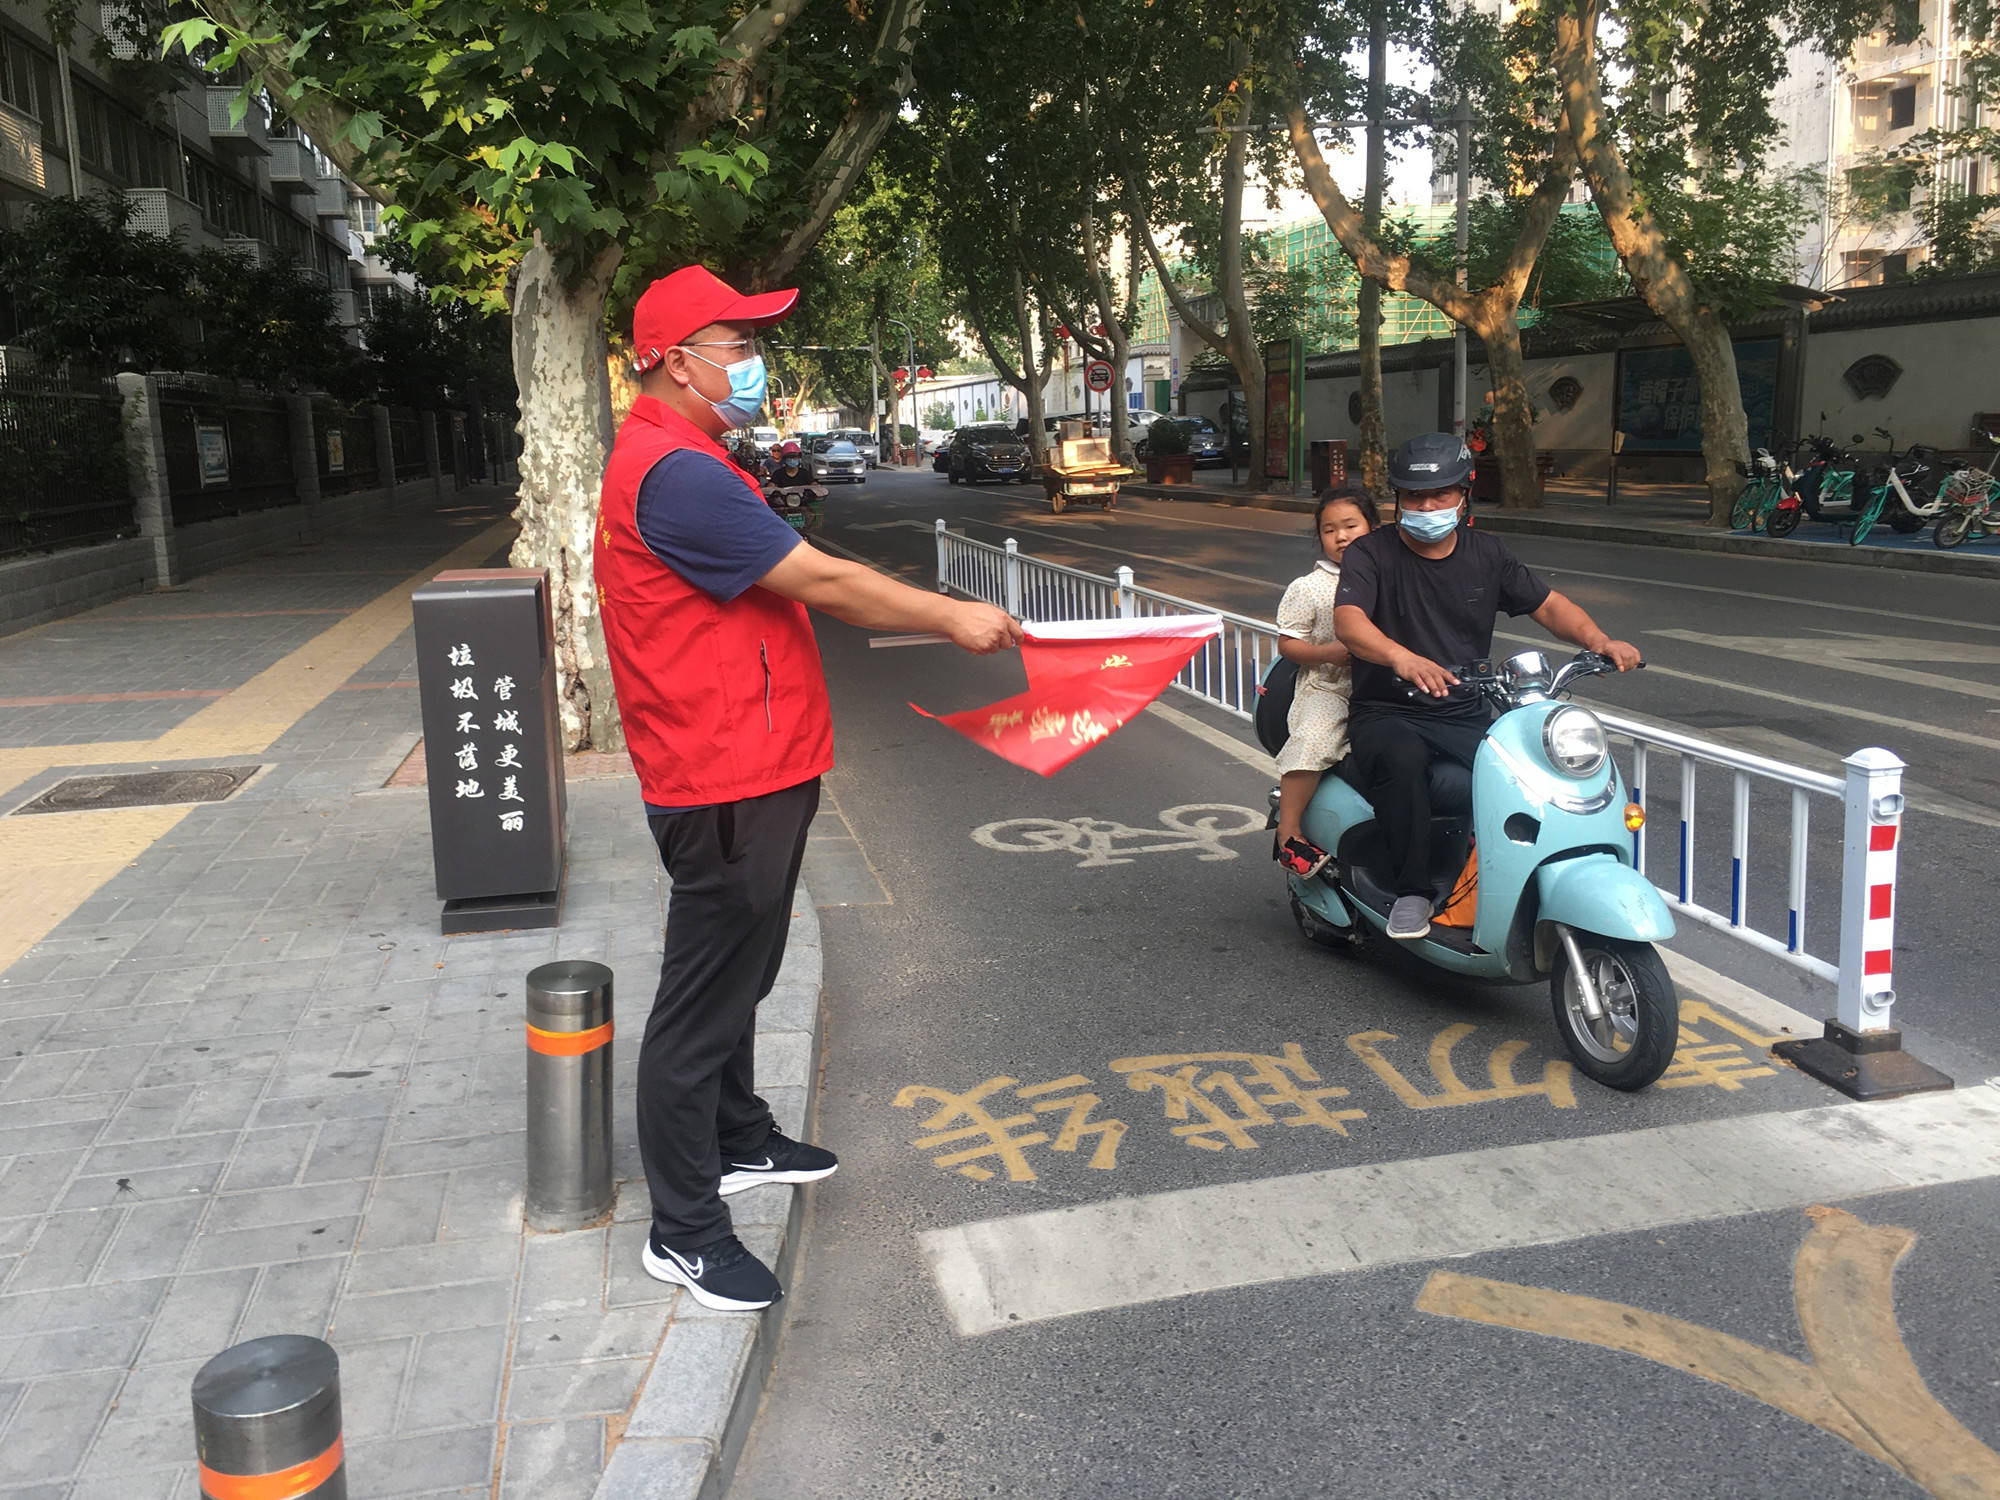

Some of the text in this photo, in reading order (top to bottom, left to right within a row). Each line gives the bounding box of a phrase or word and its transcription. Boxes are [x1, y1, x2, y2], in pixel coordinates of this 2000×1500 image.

[447, 643, 485, 799] 垃圾不落地
[492, 675, 525, 832] 管城更美丽
